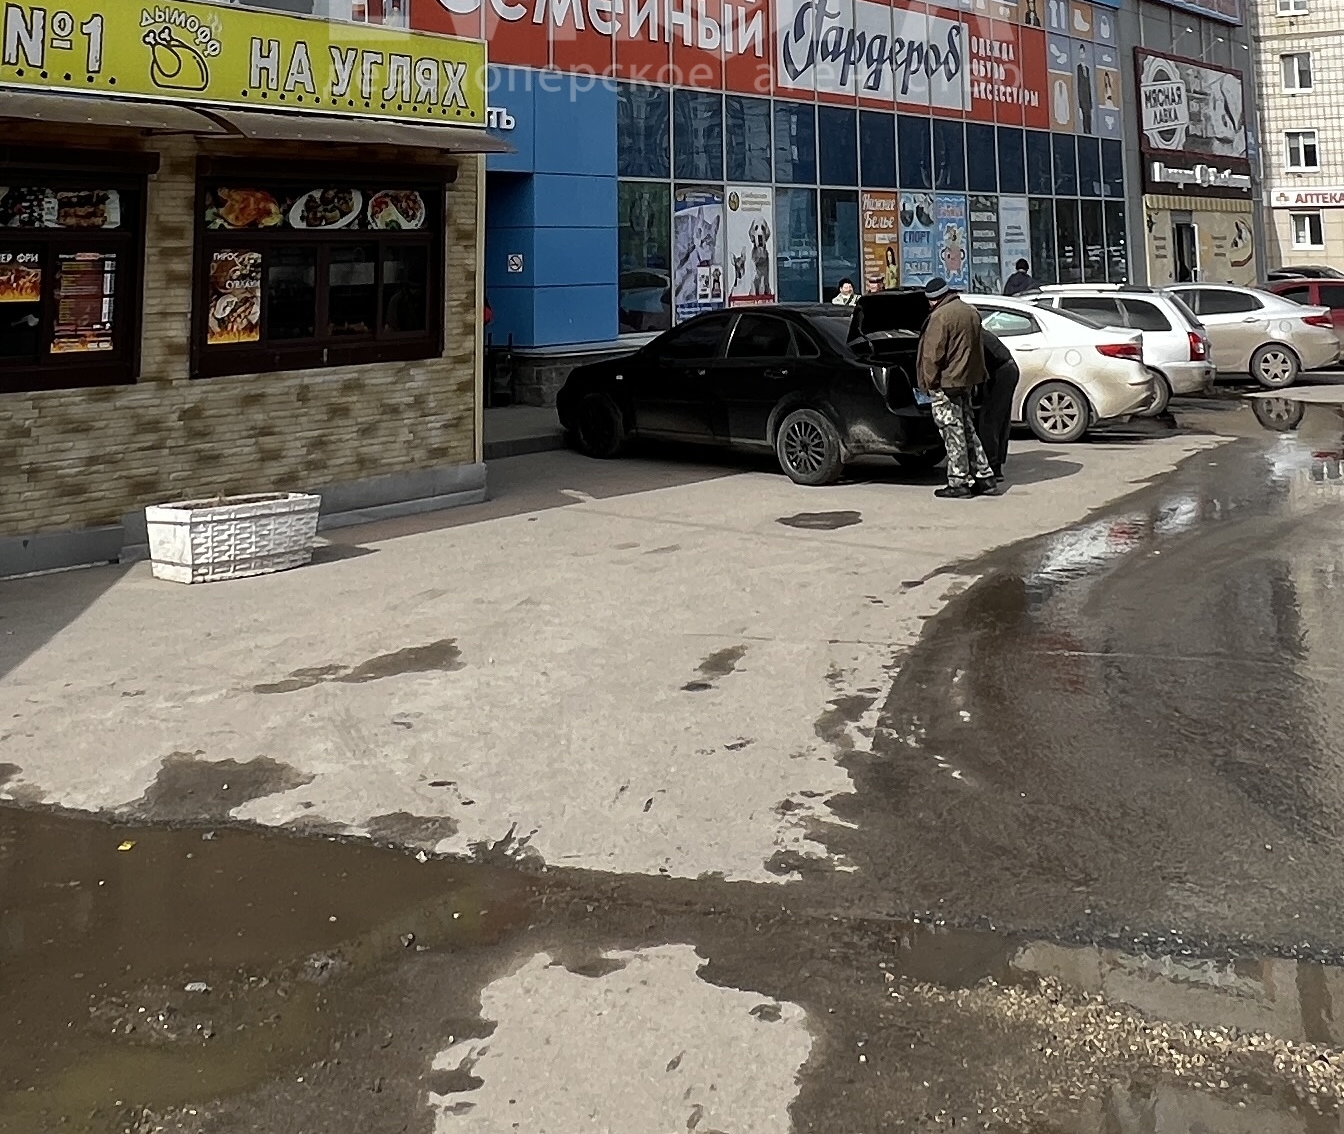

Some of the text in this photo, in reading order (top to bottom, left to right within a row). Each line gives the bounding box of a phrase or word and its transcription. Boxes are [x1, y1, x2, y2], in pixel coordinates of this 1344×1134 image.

[1, 2, 105, 74] №1
[139, 5, 223, 59] ДЫМОФФ
[971, 35, 1015, 62] ОДЕЖДА
[248, 37, 469, 109] НА УГЛЯХ
[972, 58, 1006, 81] ОБУВЬ
[1143, 85, 1183, 110] МЯСНАЯ
[1152, 107, 1180, 126] ЛАВКА
[903, 230, 931, 243] СПОРТ
[16, 253, 39, 263] ФРИ
